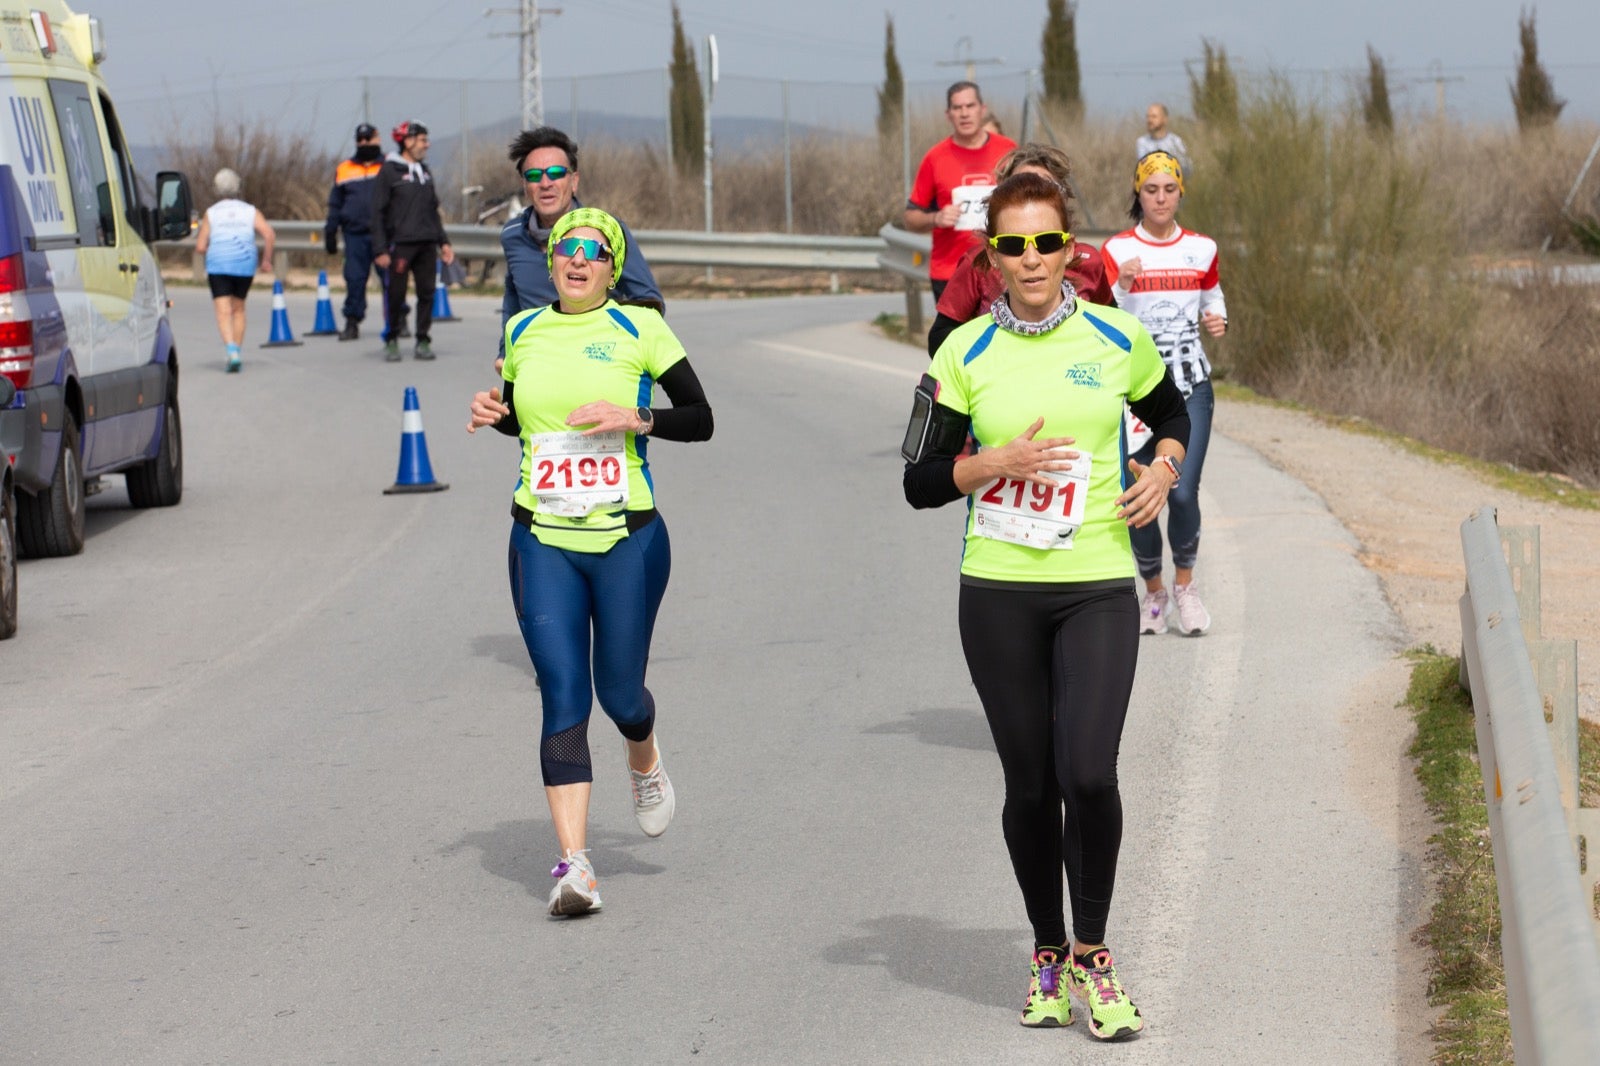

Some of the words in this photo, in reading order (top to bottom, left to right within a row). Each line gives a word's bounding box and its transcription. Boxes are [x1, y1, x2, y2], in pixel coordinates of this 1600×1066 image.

[9, 96, 56, 176] UVI
[27, 180, 64, 223] MOVIL
[1132, 277, 1199, 291] MERIDA
[1073, 379, 1101, 388] RUNNERS
[536, 456, 621, 490] 2190
[981, 477, 1076, 517] 2191
